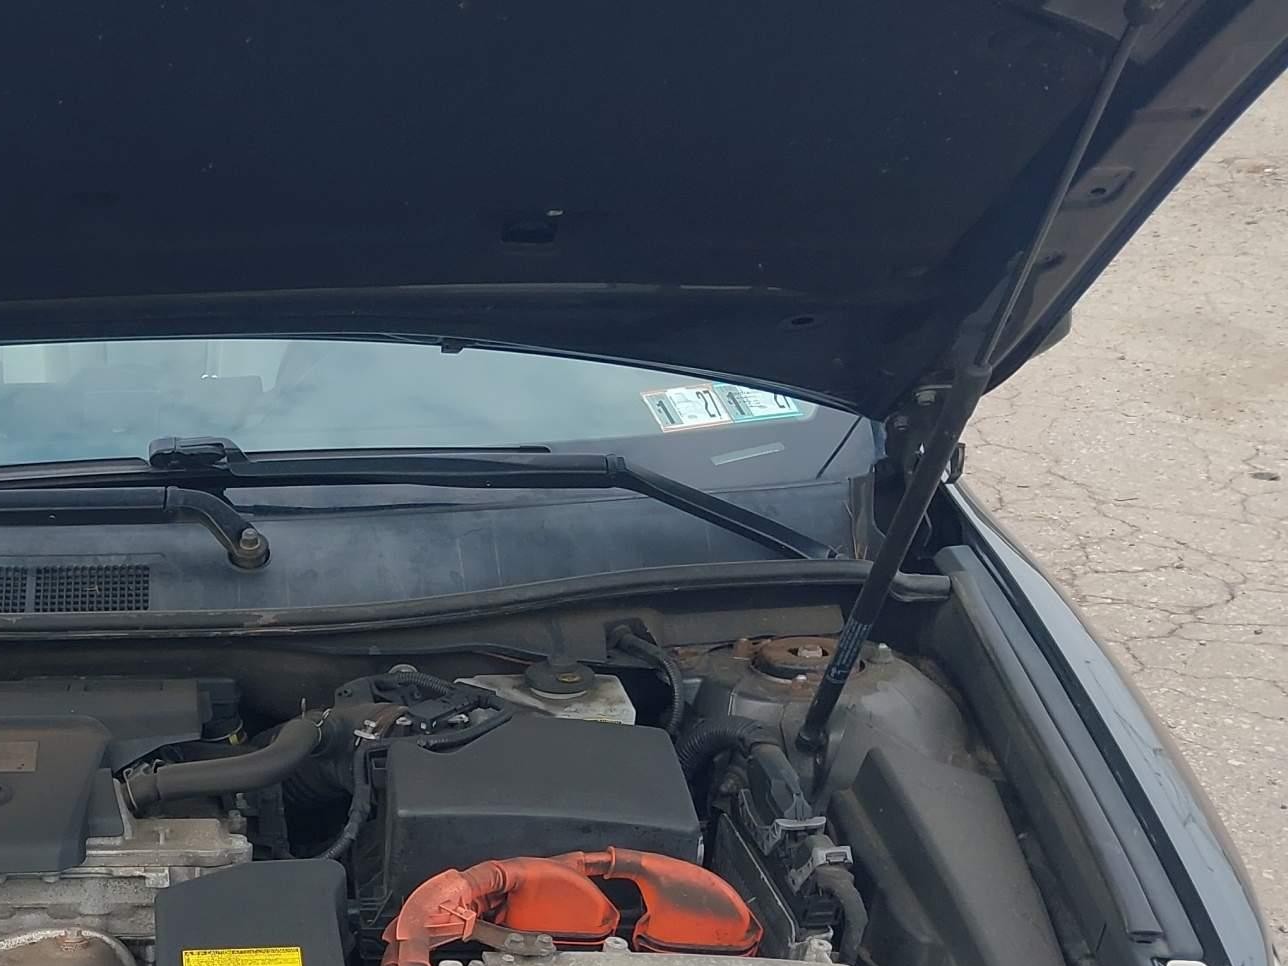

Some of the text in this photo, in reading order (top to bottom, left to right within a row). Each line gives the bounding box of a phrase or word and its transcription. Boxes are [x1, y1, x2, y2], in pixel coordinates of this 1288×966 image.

[656, 399, 675, 424] 1
[695, 390, 722, 418] 27
[726, 391, 745, 416] 1
